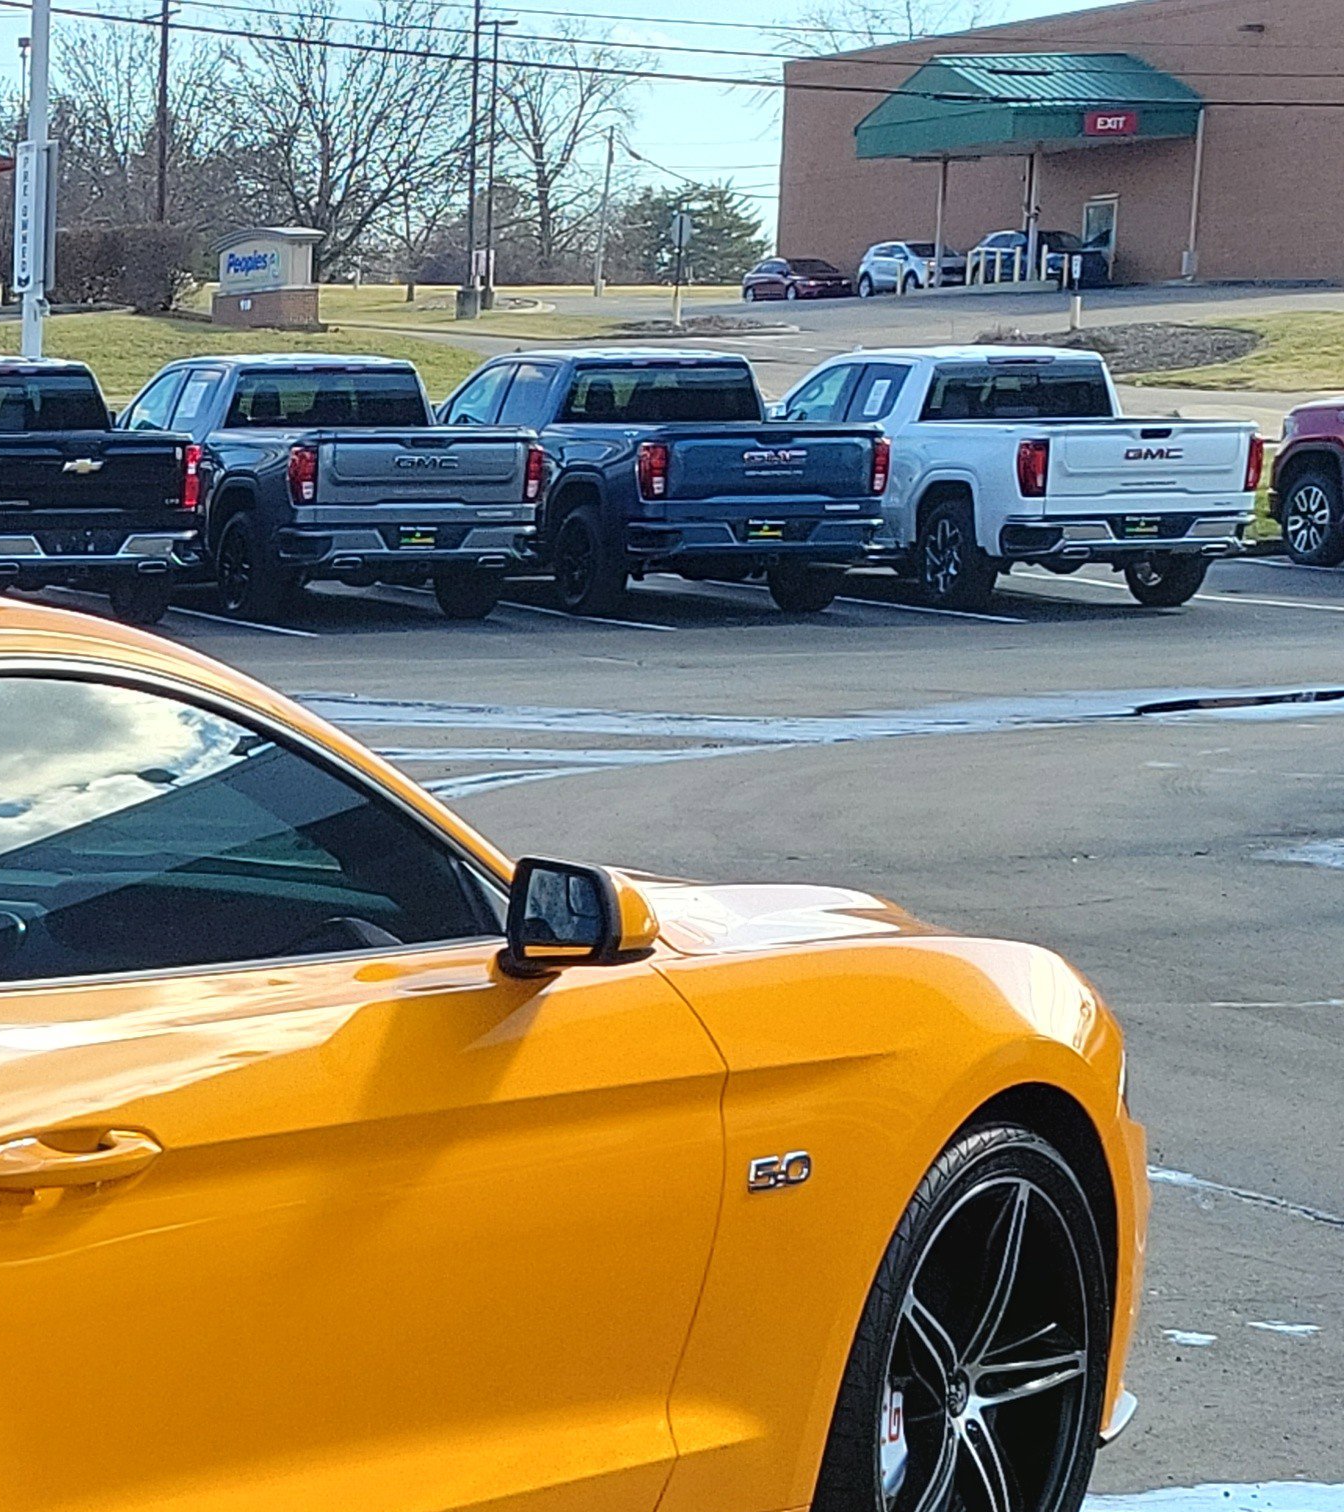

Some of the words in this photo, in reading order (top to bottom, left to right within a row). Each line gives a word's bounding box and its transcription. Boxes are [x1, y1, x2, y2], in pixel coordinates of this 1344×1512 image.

[1096, 116, 1126, 130] EXIT
[226, 250, 268, 276] Peoples
[1124, 448, 1184, 460] GMC
[395, 455, 459, 469] GMC
[748, 1150, 812, 1193] 5.0
